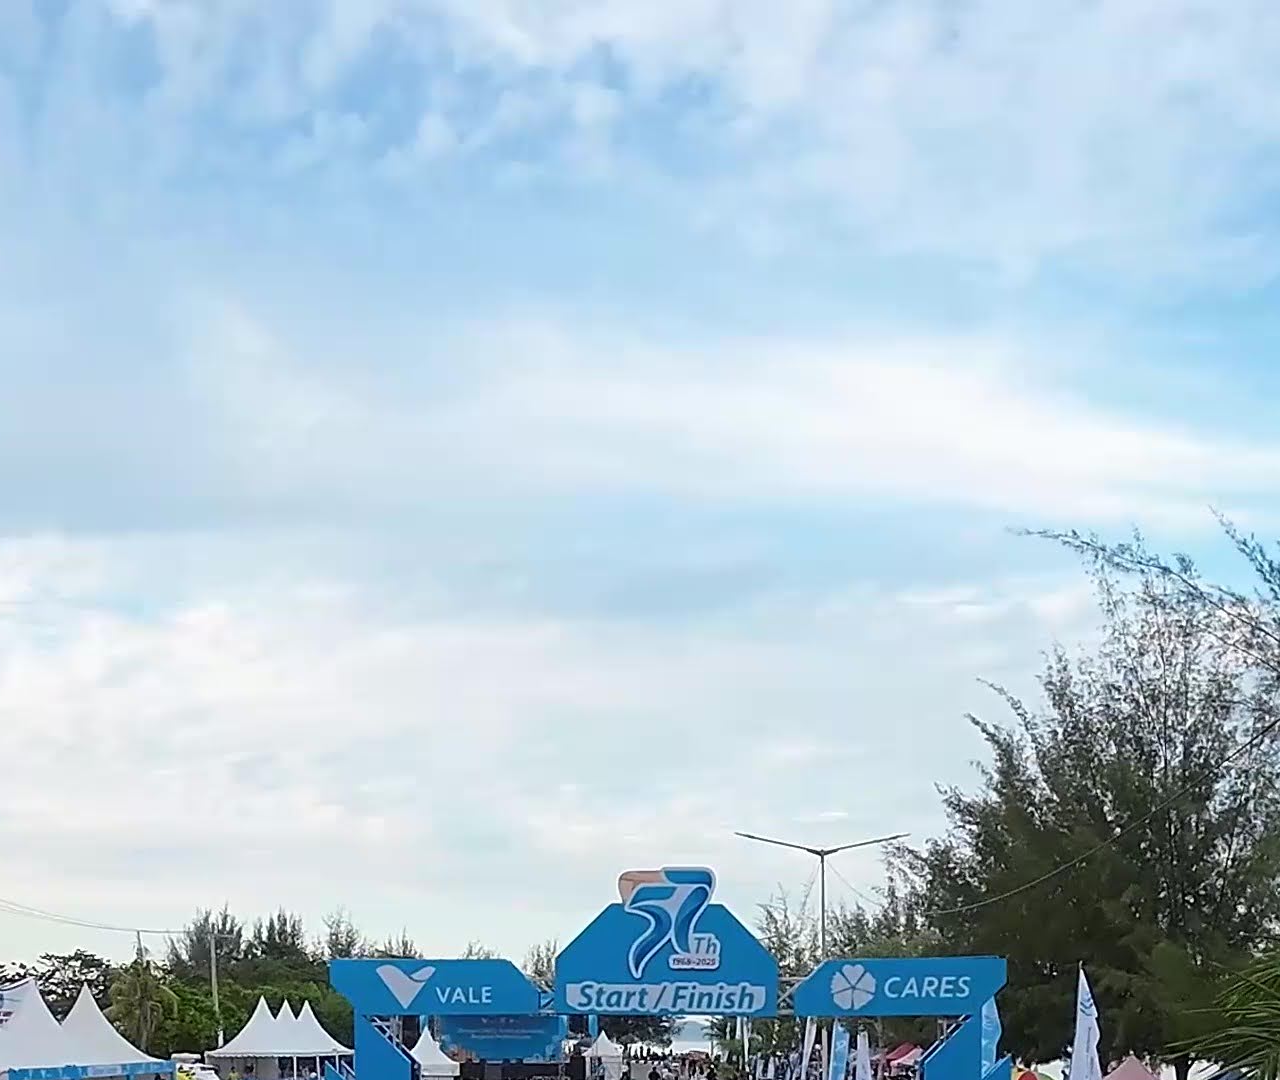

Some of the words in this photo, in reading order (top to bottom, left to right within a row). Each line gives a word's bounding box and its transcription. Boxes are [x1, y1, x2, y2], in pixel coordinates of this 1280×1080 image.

[624, 867, 715, 978] 57
[694, 937, 718, 954] Th
[435, 986, 493, 1004] VALE
[577, 983, 649, 1009] Start
[653, 985, 666, 1010] /
[671, 984, 754, 1009] Finish
[883, 976, 972, 998] CARES
